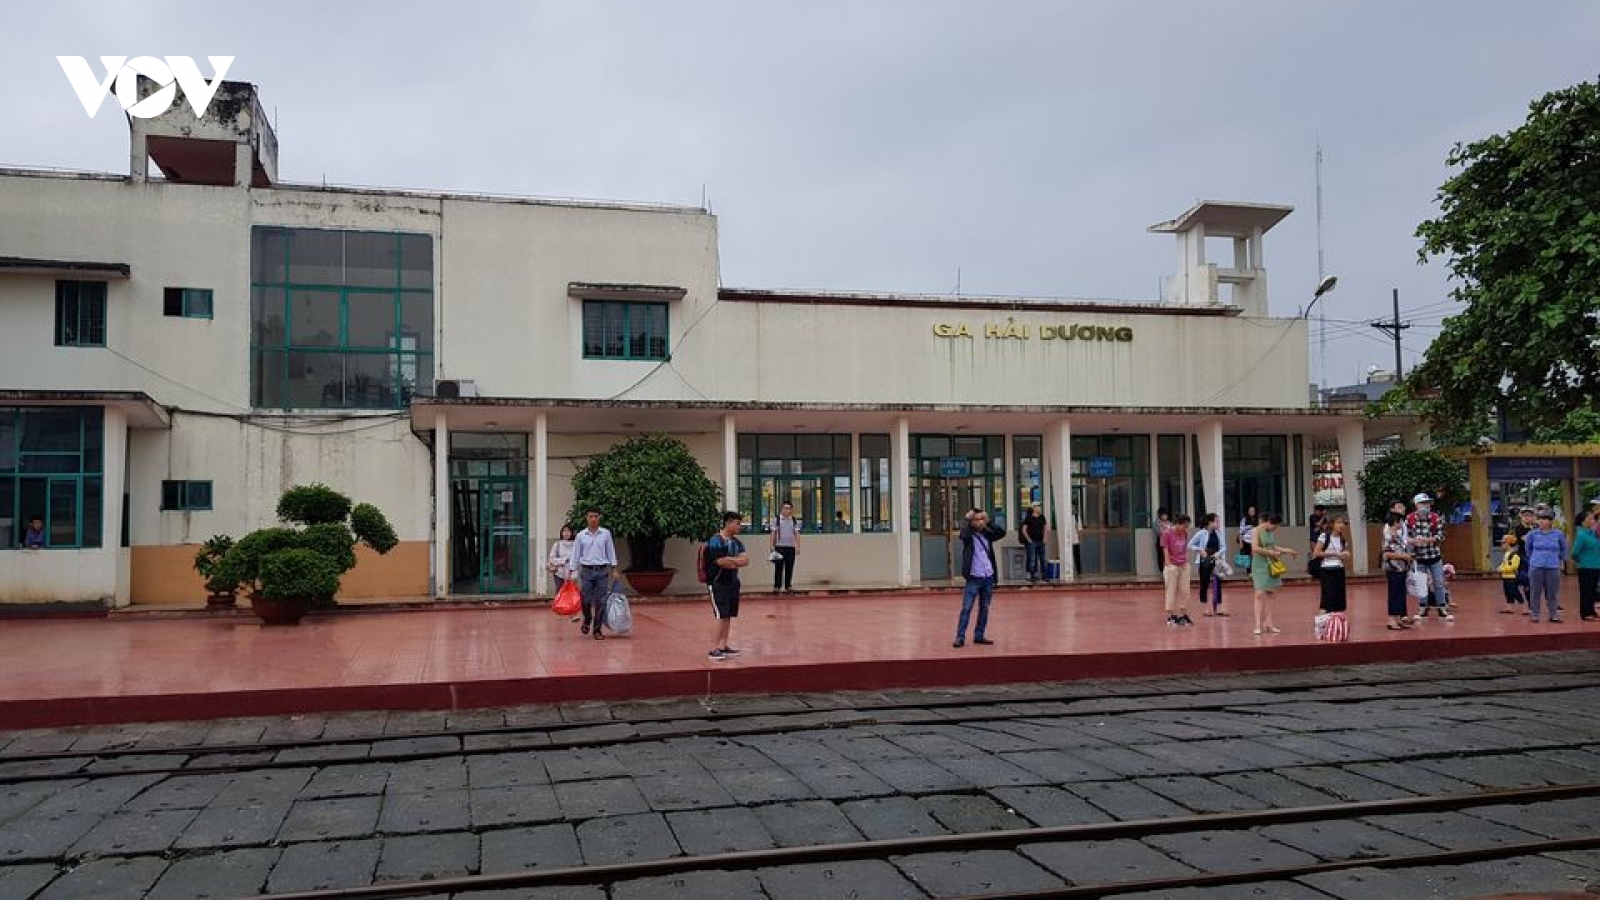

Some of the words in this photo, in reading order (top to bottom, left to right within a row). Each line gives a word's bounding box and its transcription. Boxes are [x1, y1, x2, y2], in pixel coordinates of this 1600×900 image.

[933, 323, 973, 339] GA
[984, 316, 1030, 341] HẢI
[1039, 322, 1133, 342] DƯƠNG
